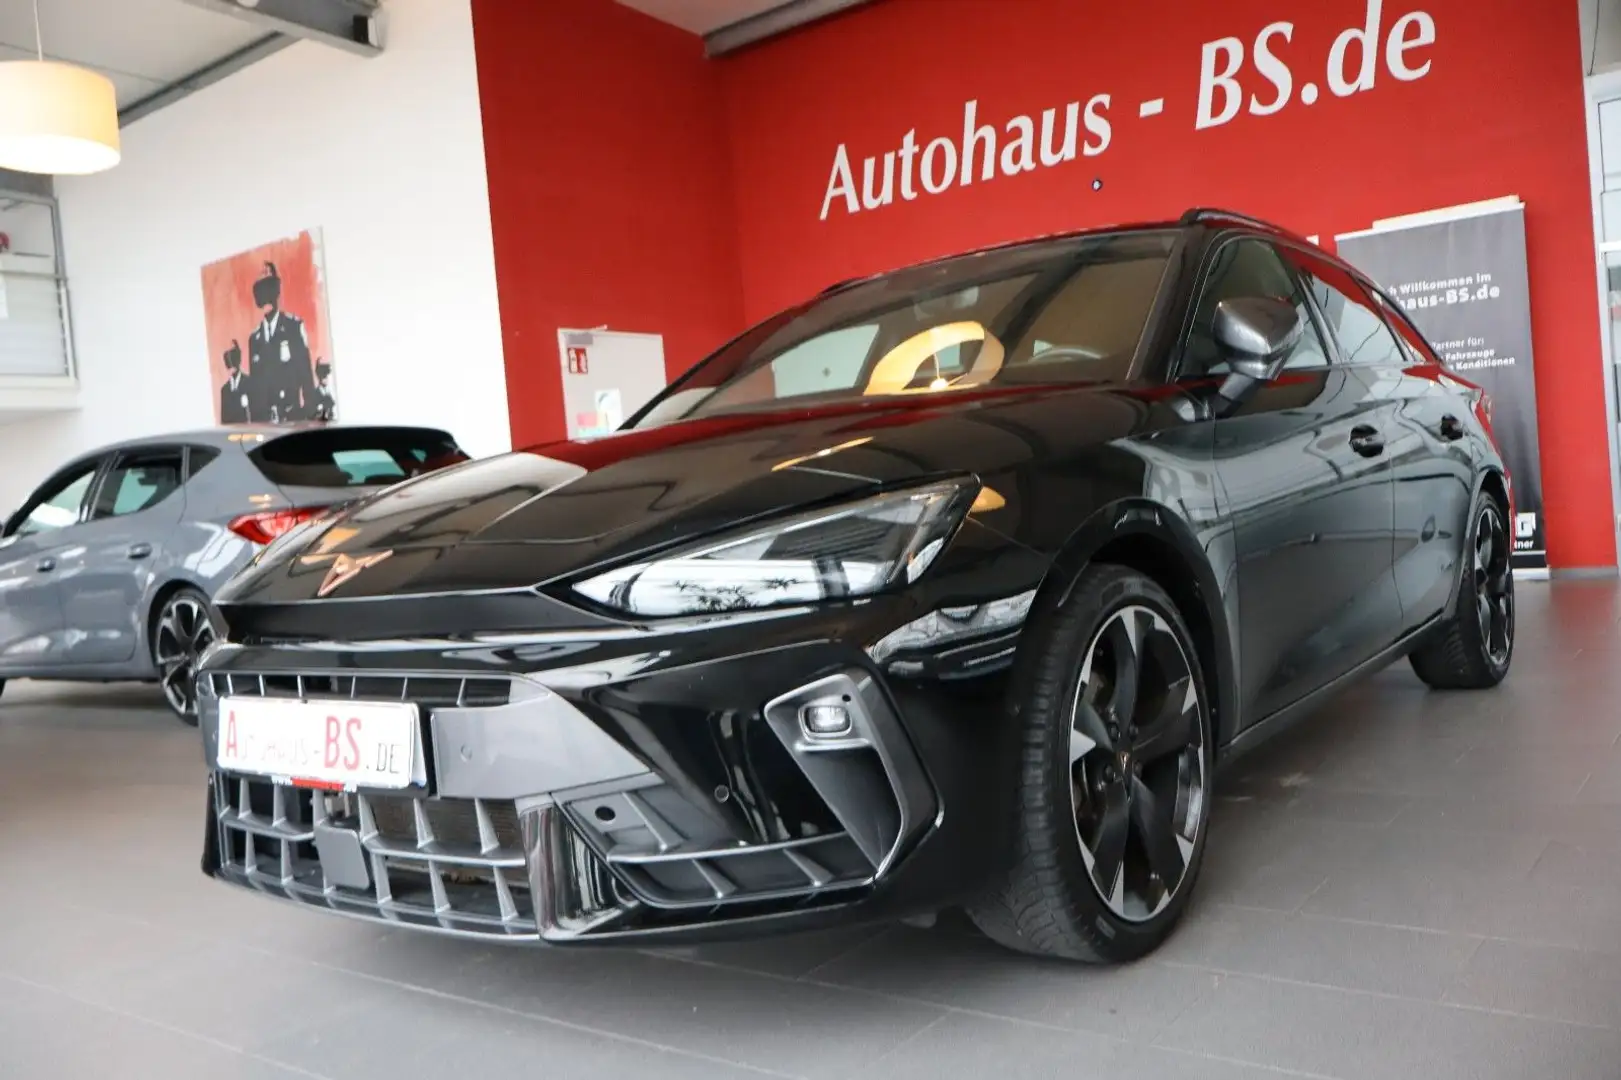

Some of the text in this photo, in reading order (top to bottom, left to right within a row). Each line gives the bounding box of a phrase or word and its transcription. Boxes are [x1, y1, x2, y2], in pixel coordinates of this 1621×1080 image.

[819, 93, 1112, 221] Autohaus
[1194, 0, 1437, 131] BS.de
[1399, 275, 1474, 295] Willkommen
